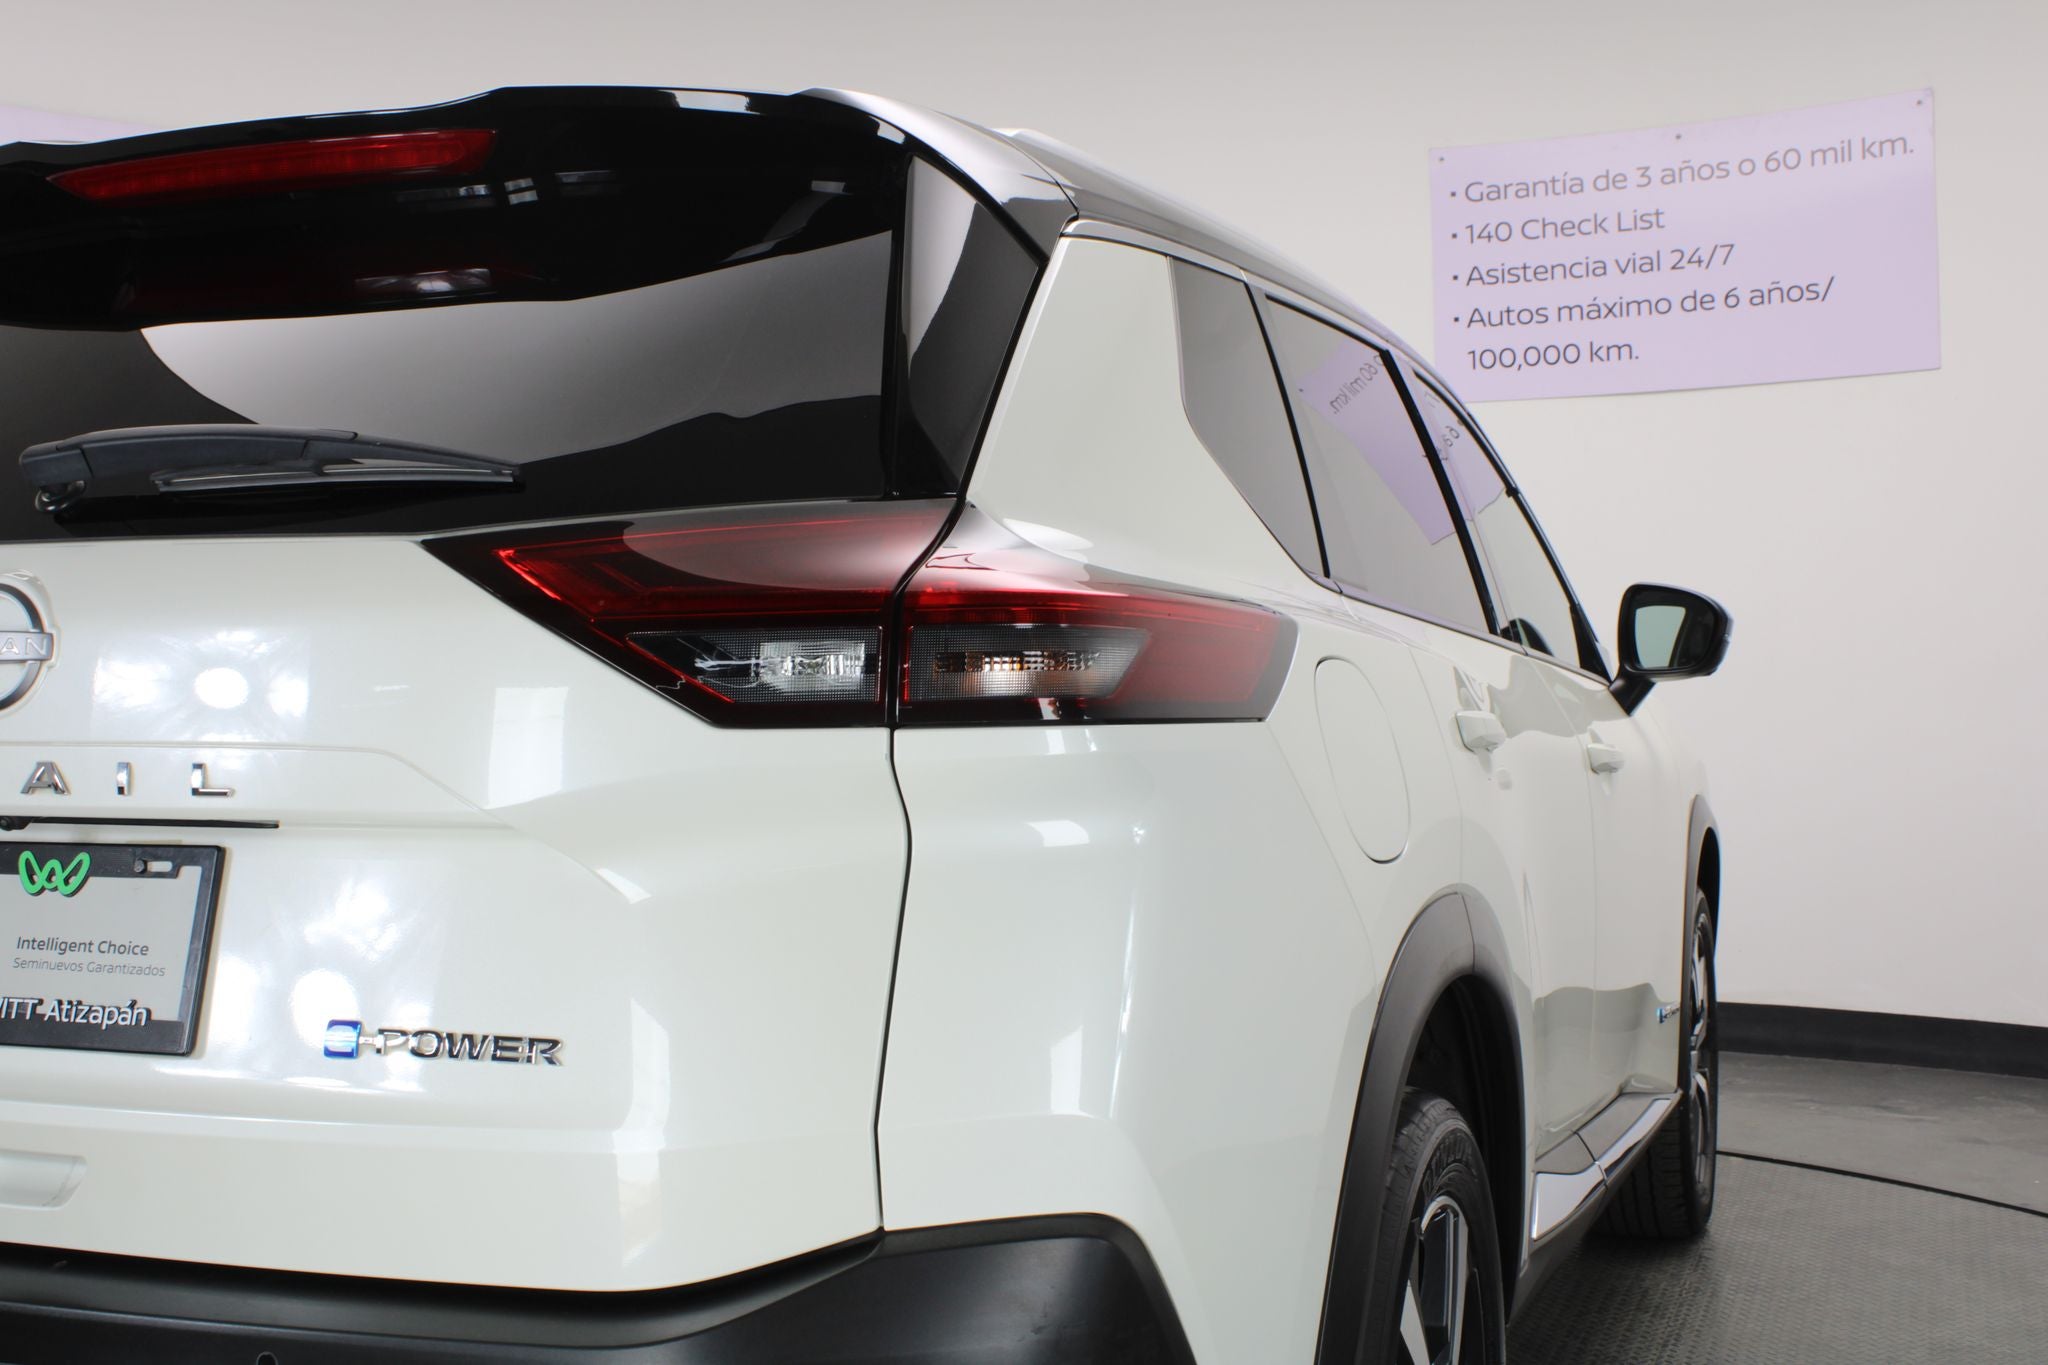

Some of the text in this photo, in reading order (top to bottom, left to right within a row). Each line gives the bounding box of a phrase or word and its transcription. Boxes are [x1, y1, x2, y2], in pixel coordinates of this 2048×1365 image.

[1465, 135, 1915, 204] Garantía de 3 años o 60 mil km.
[1464, 207, 1666, 245] 140 Check List
[1465, 243, 1736, 287] Asistencia vial 24/7
[1466, 275, 1836, 329] Autos máximo de 6 años/
[1466, 340, 1640, 372] 100,000 km.
[16, 936, 150, 956] Intelligent Choice
[12, 957, 166, 977] Seminuevos Garantizados
[0, 997, 148, 1031] ITT Atizapán
